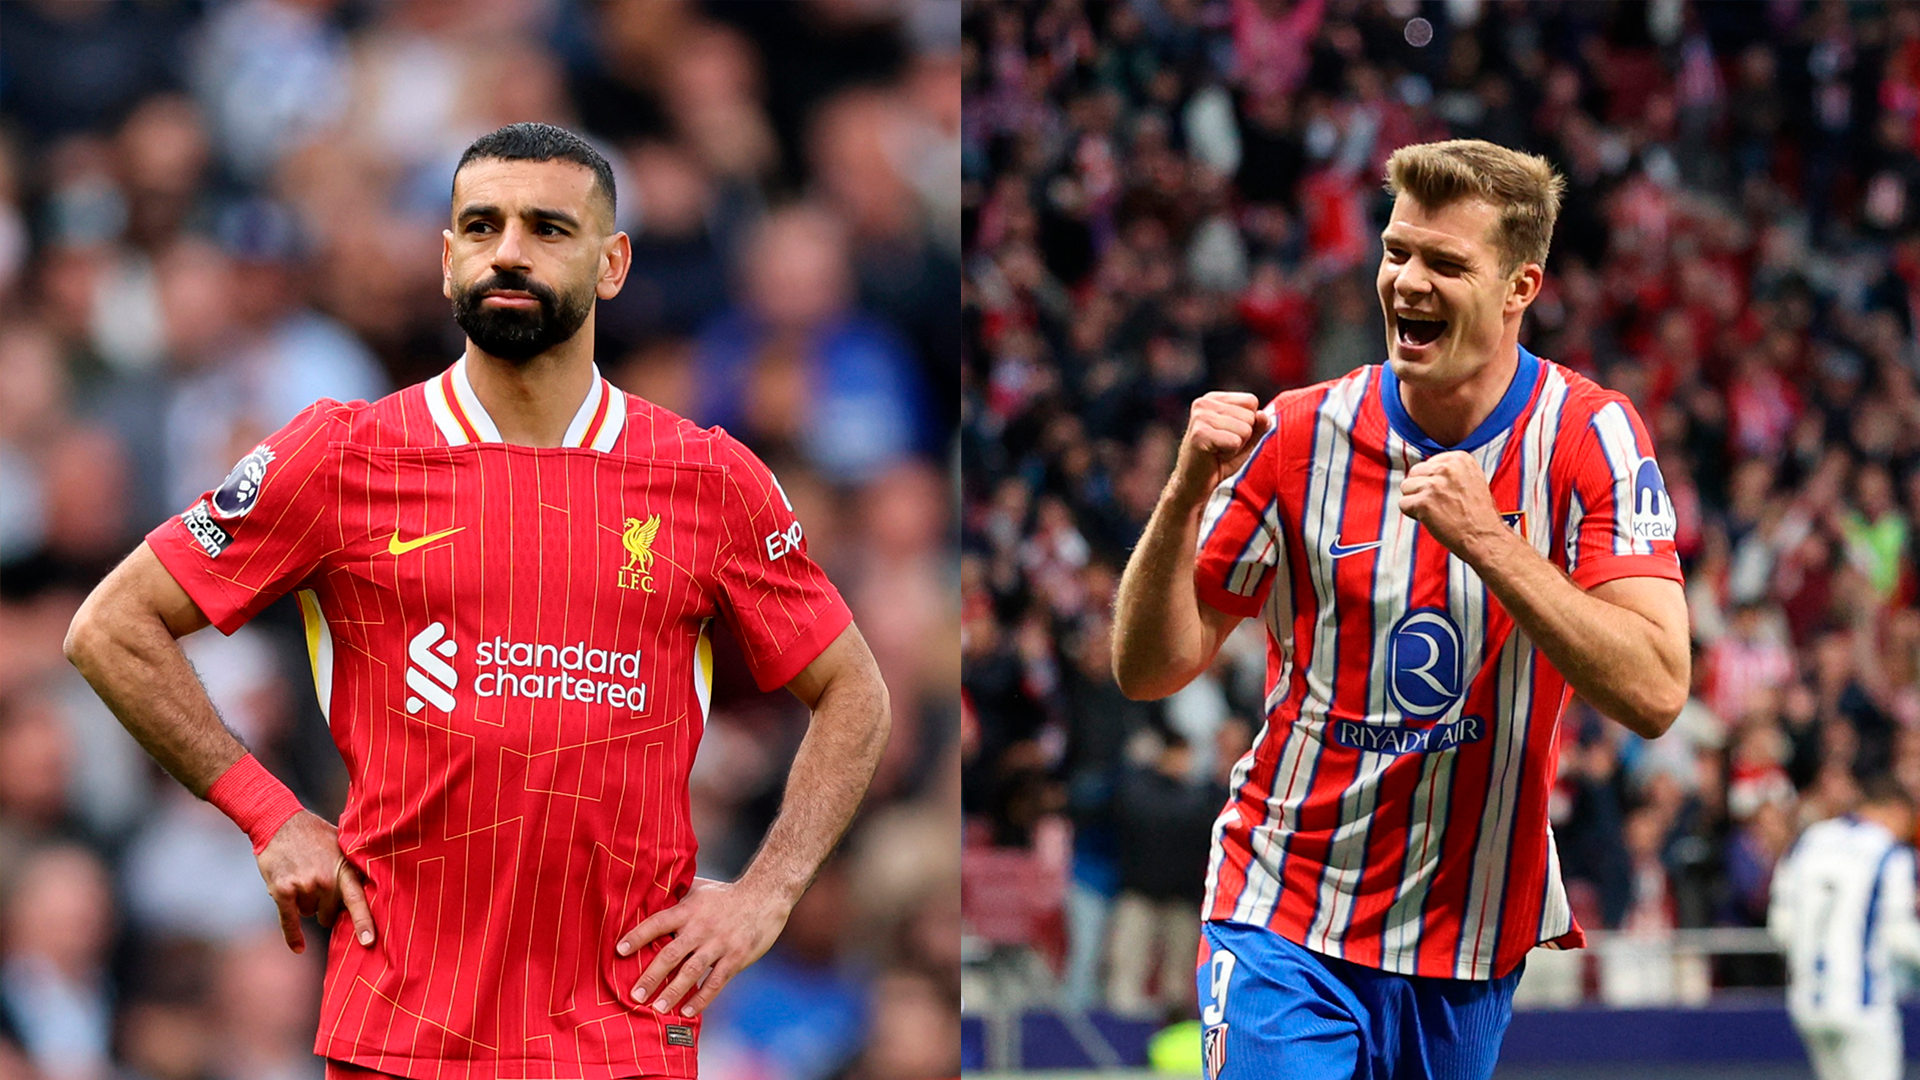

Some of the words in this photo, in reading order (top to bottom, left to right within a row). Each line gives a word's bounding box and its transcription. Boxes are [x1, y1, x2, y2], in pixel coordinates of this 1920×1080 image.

[183, 514, 222, 559] racism
[475, 635, 641, 679] standard
[474, 667, 646, 712] chartered
[1438, 718, 1478, 749] AIR
[1203, 949, 1237, 1026] 9
